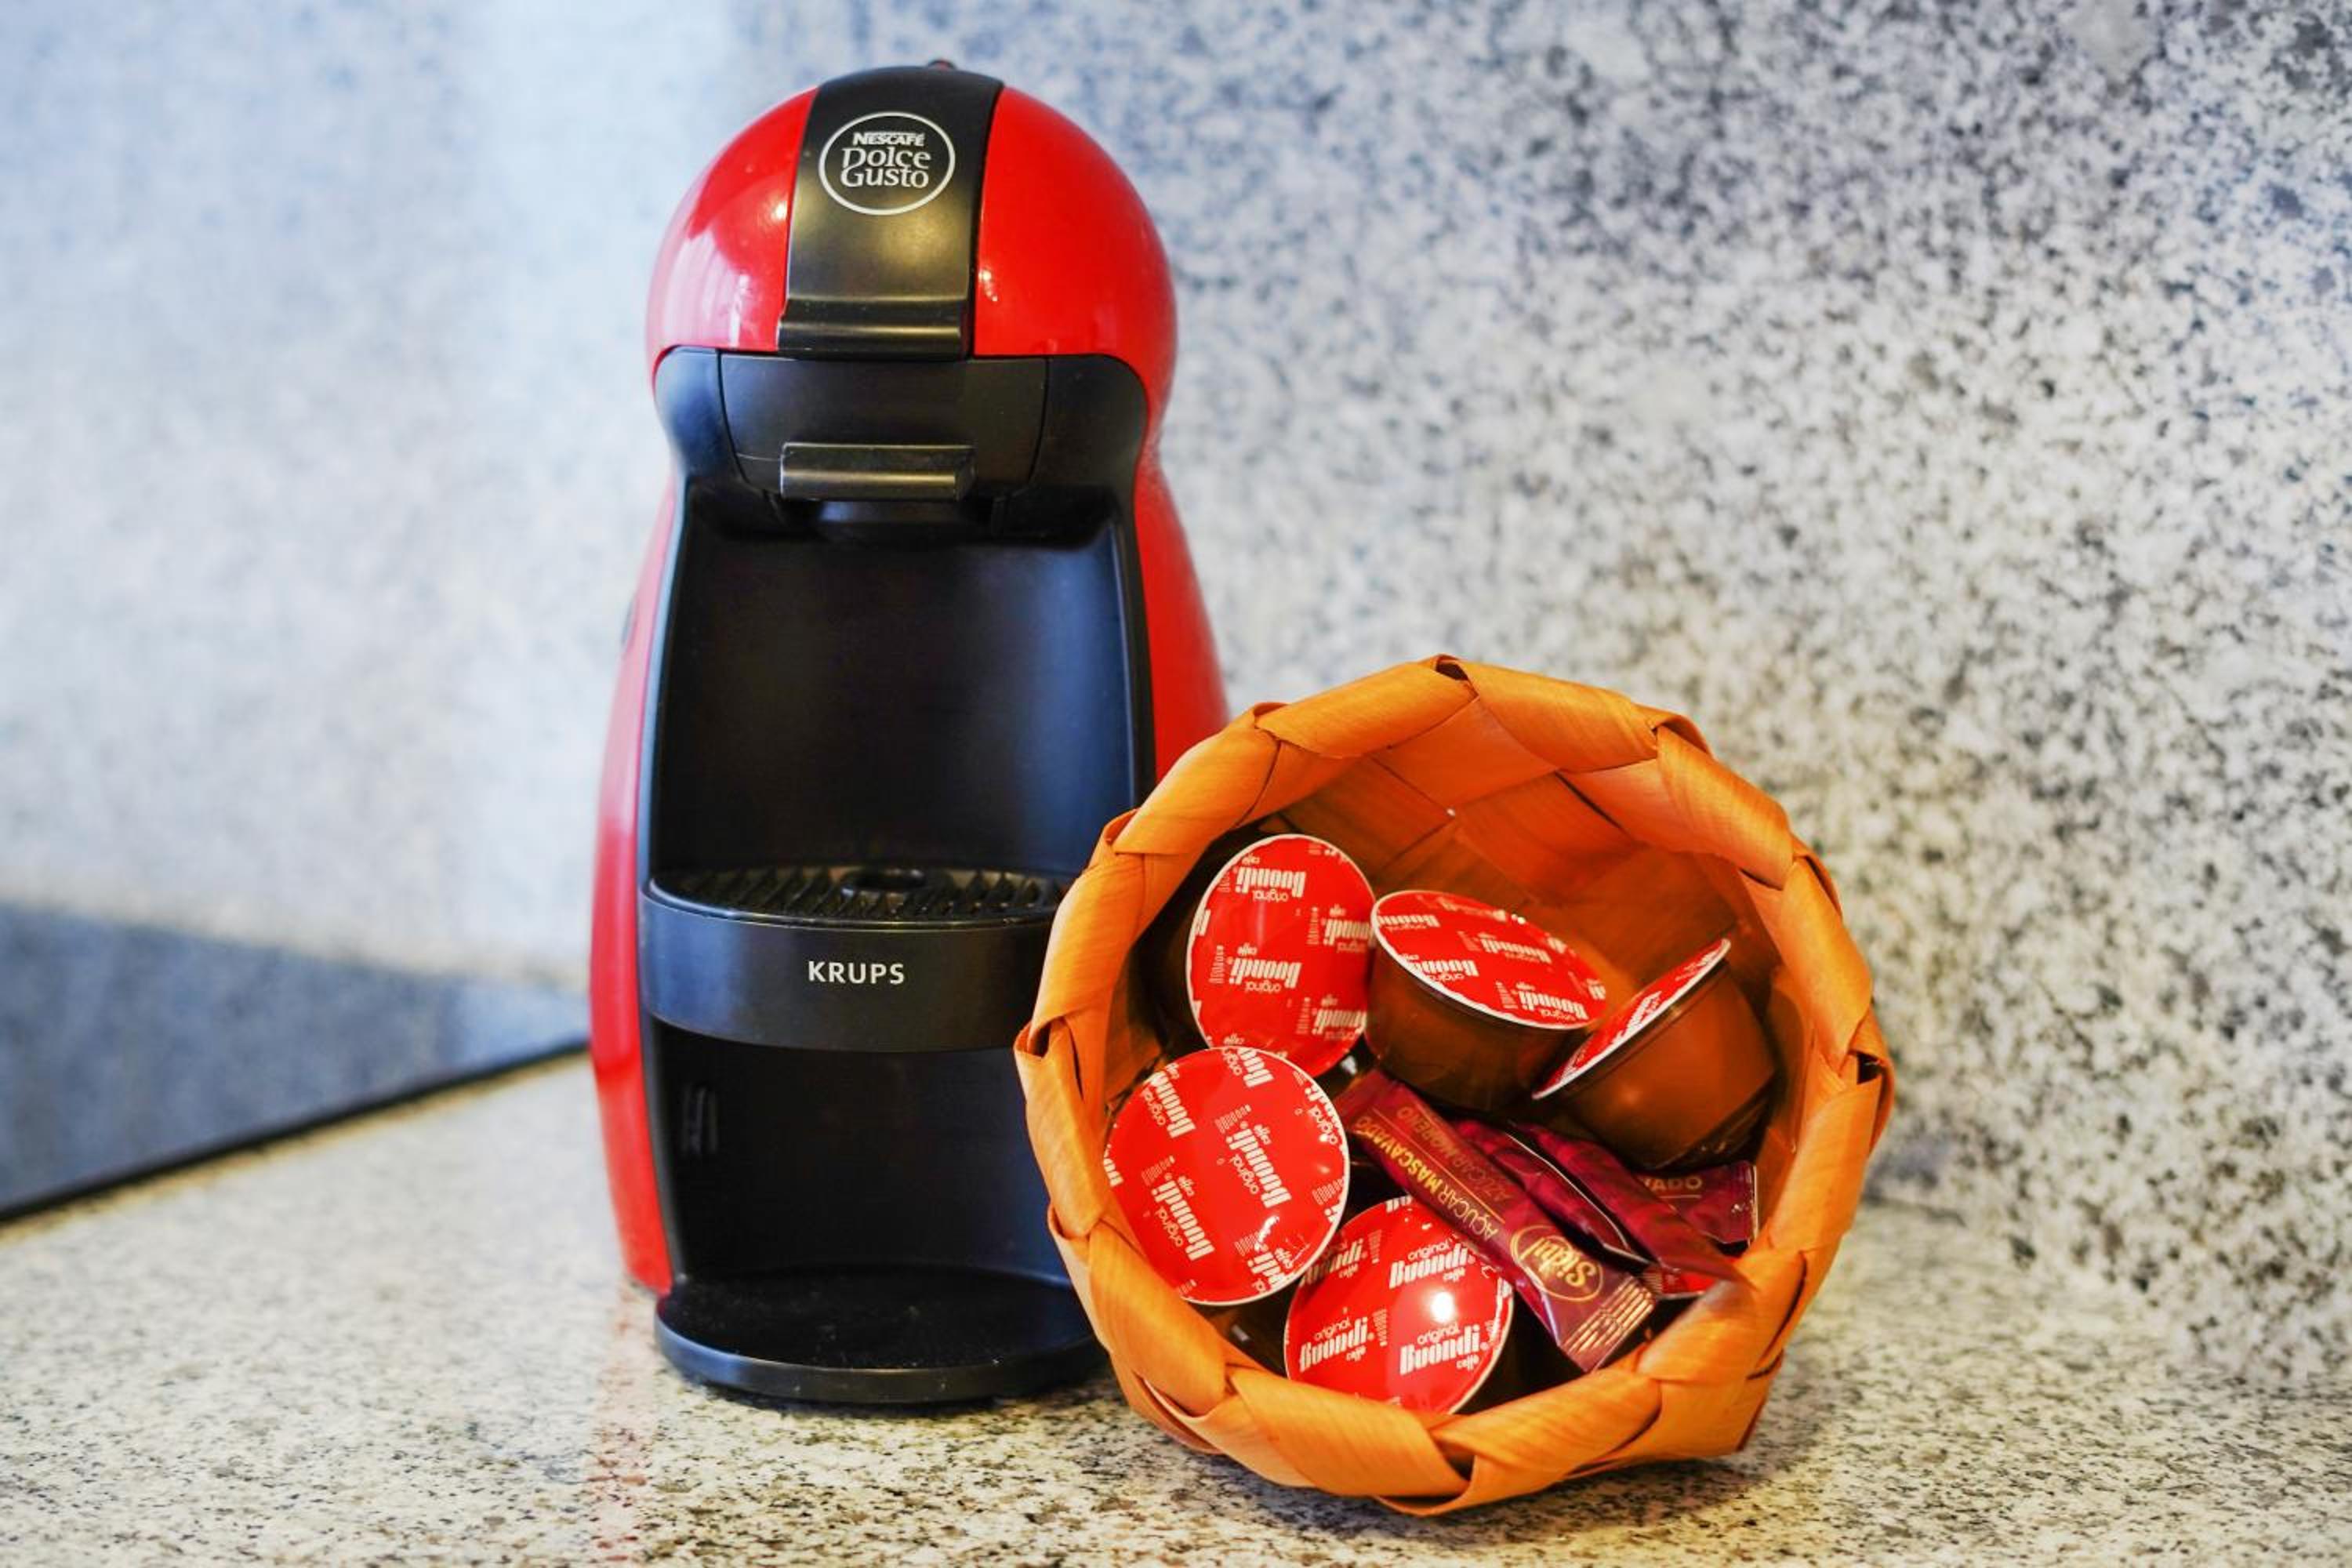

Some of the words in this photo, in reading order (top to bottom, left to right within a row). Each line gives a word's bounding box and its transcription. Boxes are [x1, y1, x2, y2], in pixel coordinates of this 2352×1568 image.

[841, 147, 931, 169] Dolce
[852, 131, 926, 147] NESCAFÉ
[840, 165, 930, 189] Gusto
[808, 960, 905, 985] KRUPS
[1229, 956, 1303, 989] Buondi
[1225, 1127, 1292, 1209] Buondi
[1151, 1179, 1215, 1261] Buondi
[1388, 1243, 1469, 1290] Buondi
[1521, 1236, 1597, 1287] Sidul
[1298, 1316, 1369, 1373] Buondi
[1399, 1323, 1481, 1376] Buondi
